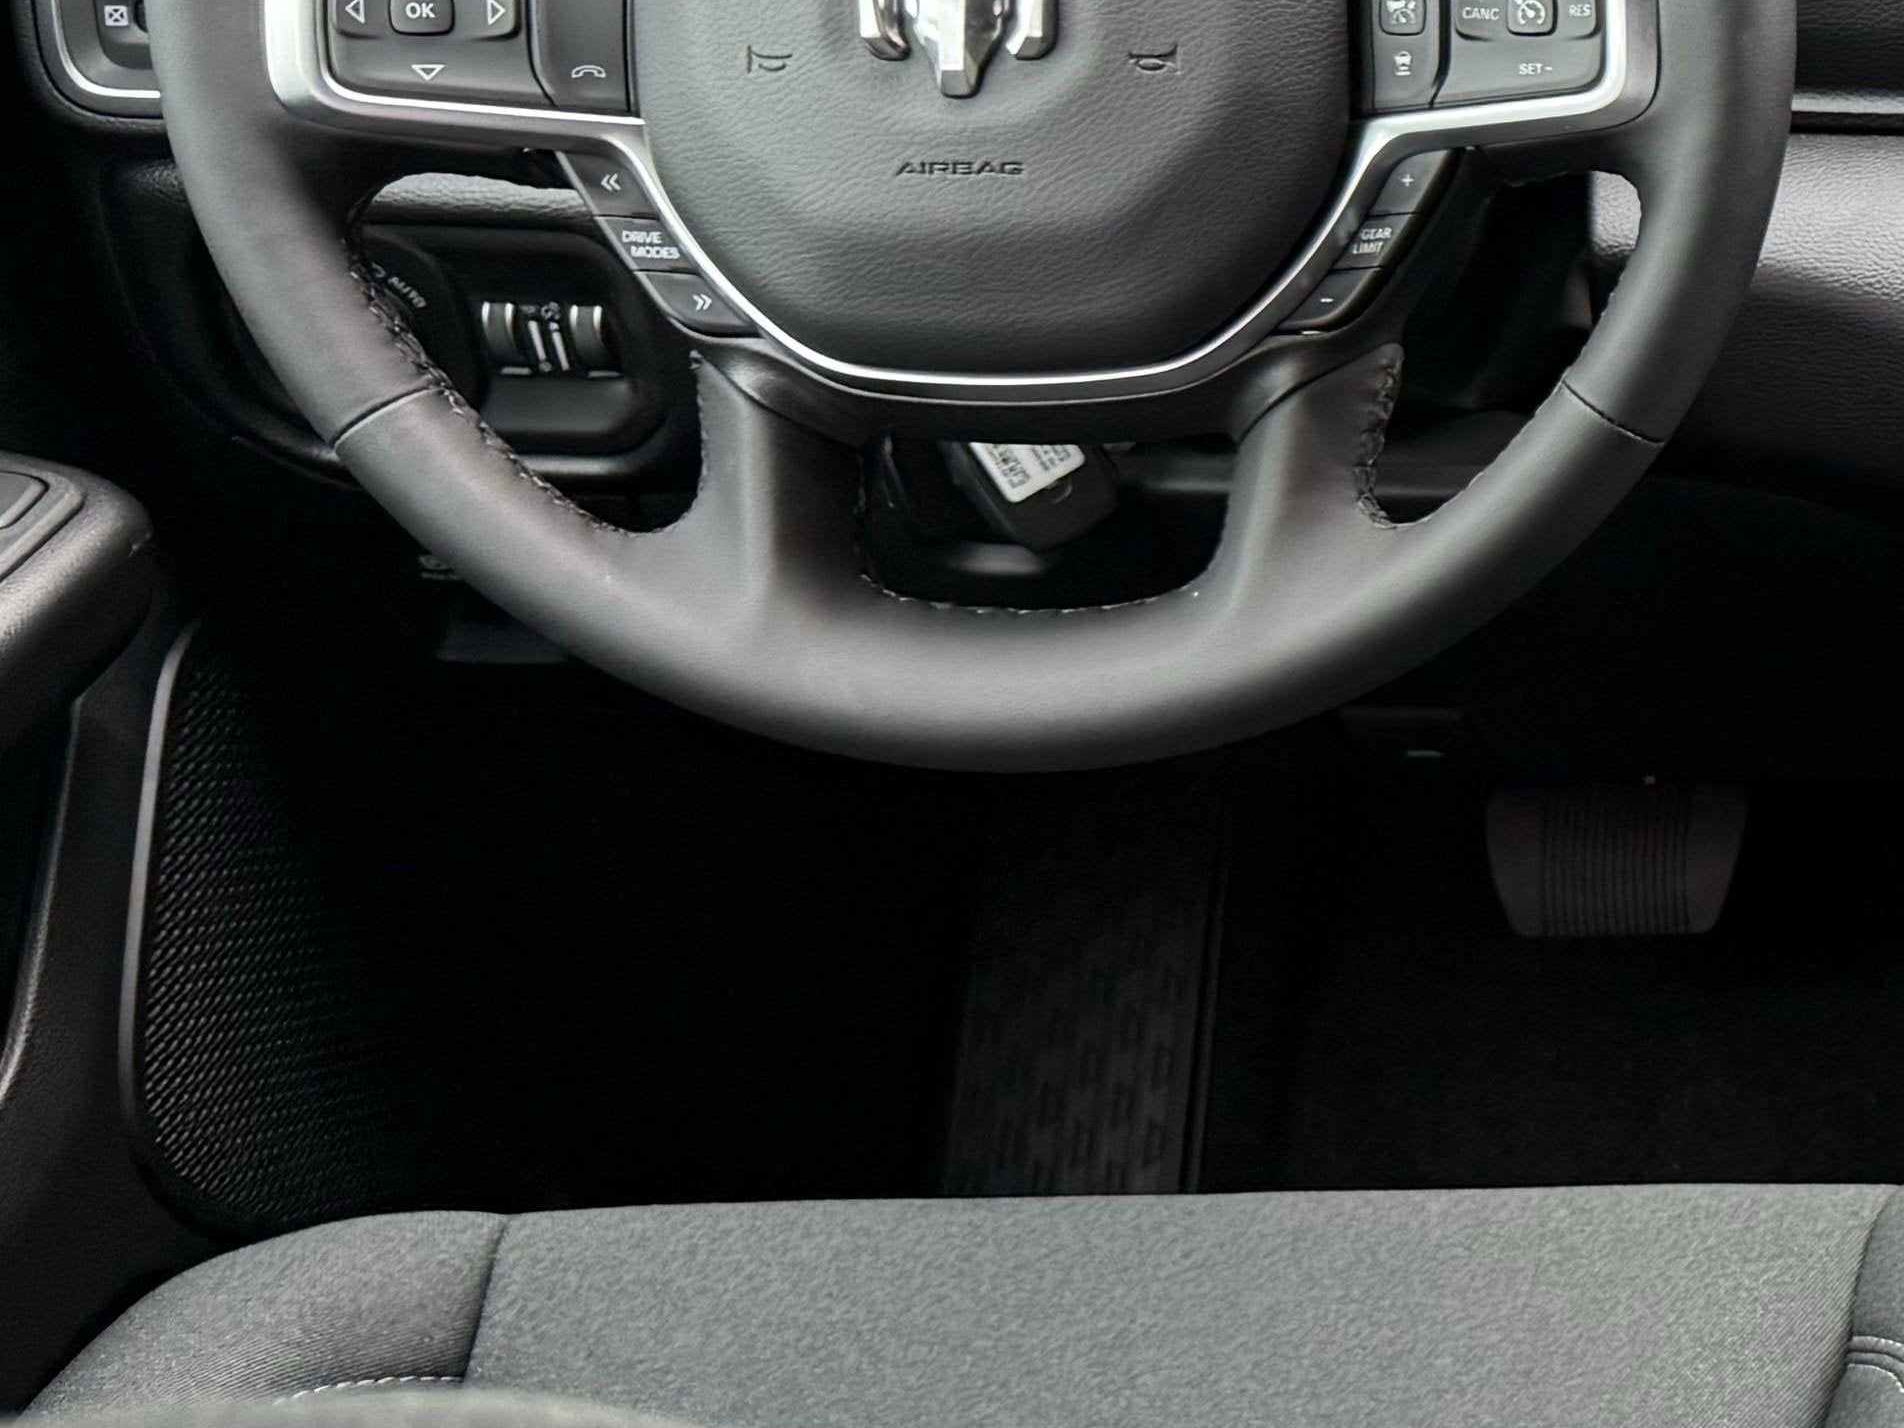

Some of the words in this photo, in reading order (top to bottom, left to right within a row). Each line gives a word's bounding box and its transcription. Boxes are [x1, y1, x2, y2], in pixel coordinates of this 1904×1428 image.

[405, 2, 436, 19] OK
[1462, 6, 1500, 21] CANC
[1568, 4, 1591, 17] RES
[895, 160, 1024, 176] AIRBAG
[622, 230, 663, 244] DRIVE
[1361, 228, 1393, 240] GEAR
[630, 246, 680, 260] MODES
[1352, 242, 1384, 255] LIMIT
